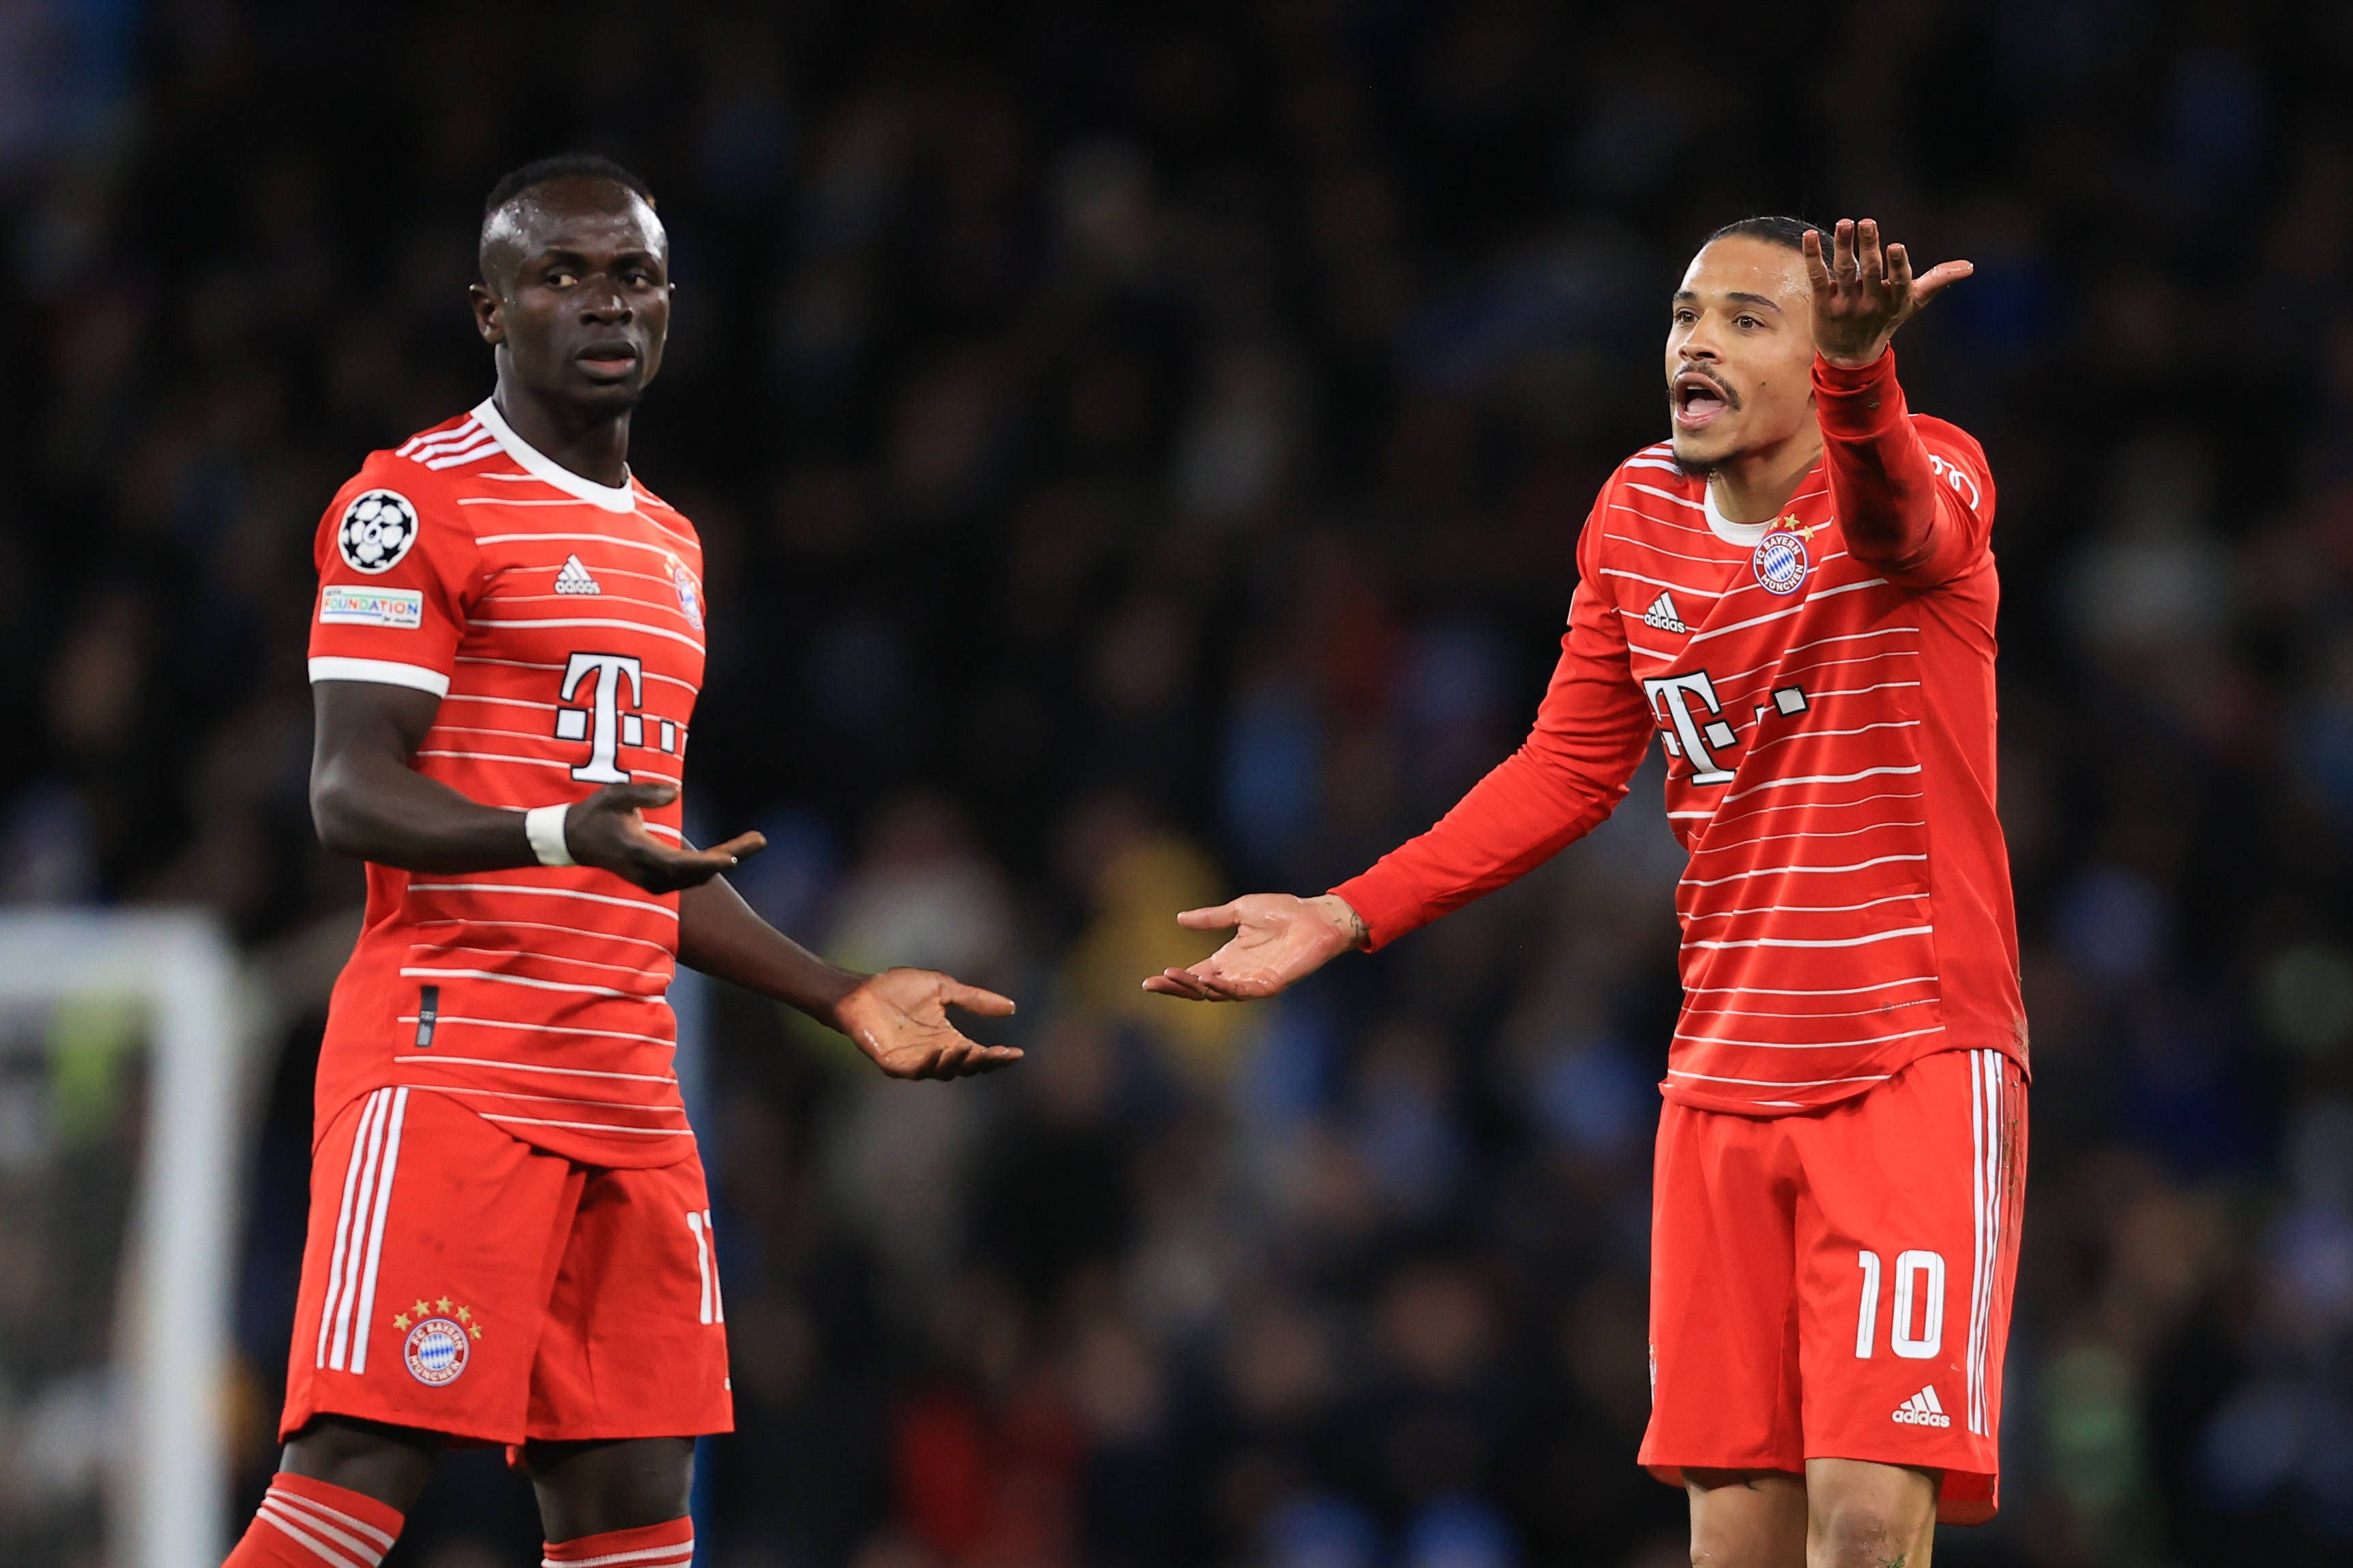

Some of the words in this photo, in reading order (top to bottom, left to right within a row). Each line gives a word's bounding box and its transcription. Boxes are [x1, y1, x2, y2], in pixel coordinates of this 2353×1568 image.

[1756, 550, 1766, 565] FC
[1764, 536, 1802, 556] BAYERN
[324, 597, 418, 615] FOUNDATION
[1644, 613, 1686, 634] adidas
[1855, 1249, 1946, 1359] 10
[426, 1322, 464, 1351] BAYERN
[1891, 1409, 1950, 1428] adidas
